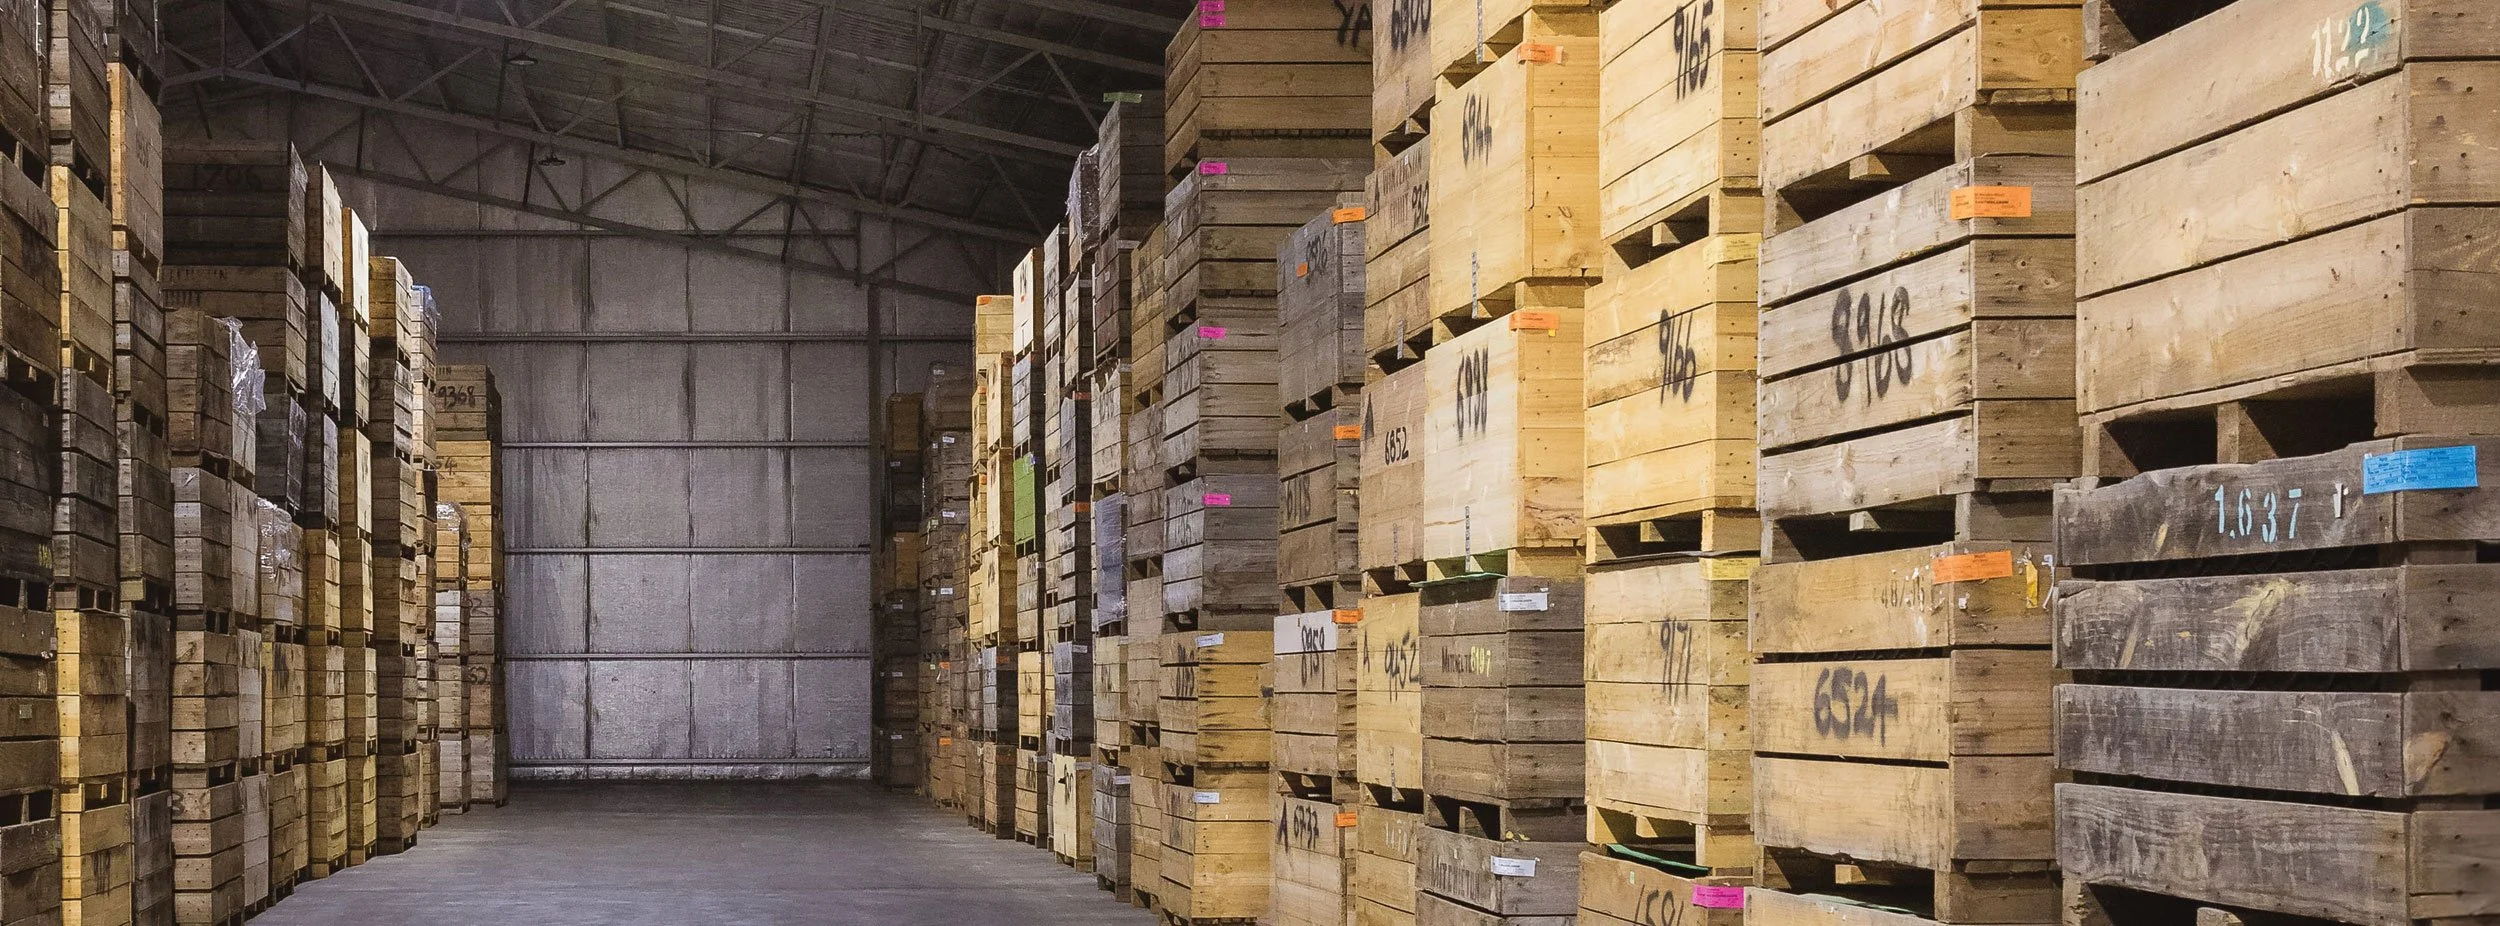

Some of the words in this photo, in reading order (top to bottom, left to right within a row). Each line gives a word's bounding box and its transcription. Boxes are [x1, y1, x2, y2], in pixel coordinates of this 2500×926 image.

[1674, 0, 1713, 102] 9165
[2311, 6, 2370, 82] 1122
[1462, 91, 1493, 171] 6944
[1659, 309, 1697, 407] 9166
[1831, 286, 1913, 407] 8968
[436, 384, 477, 411] 9368
[1385, 426, 1409, 466] 6852
[1301, 625, 1325, 690] 8959
[1363, 629, 1371, 674] A
[1660, 615, 1692, 705] 9171
[1814, 665, 1899, 748] 6524
[1277, 799, 1289, 854] A
